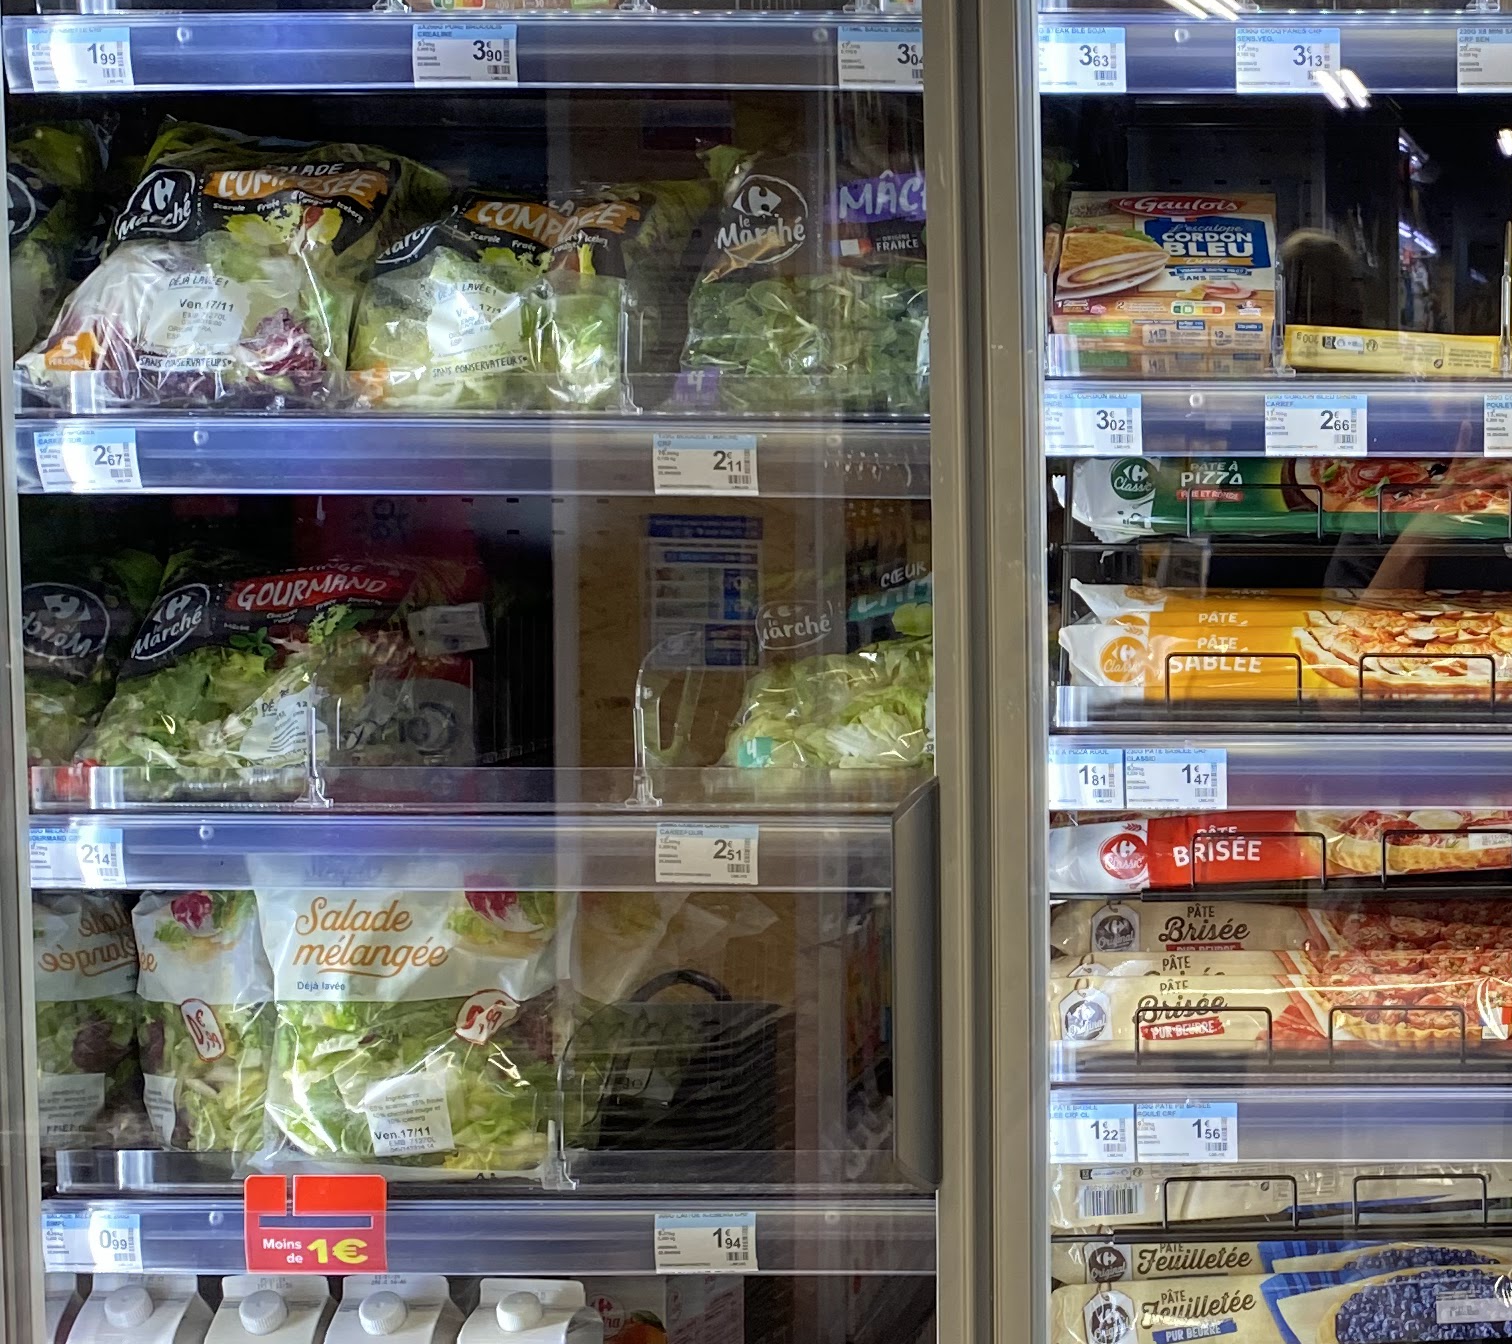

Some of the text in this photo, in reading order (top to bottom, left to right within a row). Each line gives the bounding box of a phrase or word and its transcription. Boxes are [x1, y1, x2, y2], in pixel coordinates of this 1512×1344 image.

[1135, 197, 1238, 212] Gaulois
[739, 216, 750, 228] le
[716, 214, 806, 253] Marché
[1162, 232, 1253, 243] CORDON
[876, 239, 919, 253] FRANCE
[1163, 242, 1254, 257] BLEU
[1181, 472, 1243, 487] PIZZA
[237, 572, 388, 611] GOURMAND
[1198, 611, 1237, 624] PÂTE
[1197, 635, 1238, 650] PÂTE
[1169, 649, 1262, 674] SABLÉE
[1173, 836, 1262, 866] BRISÉE
[296, 896, 414, 936] Salade
[1187, 903, 1215, 918] PÂTE
[1158, 916, 1250, 943] Brisée
[293, 938, 449, 978] mélangée
[1162, 954, 1191, 971] PÂTE
[297, 980, 346, 992] Déjà lavée
[1160, 979, 1189, 994] PÂTE
[1132, 993, 1228, 1025] Brisée
[1152, 1026, 1172, 1040] PUR
[262, 1237, 302, 1251] Moins
[307, 1238, 368, 1264] 1€
[287, 1252, 303, 1264] de
[1137, 1246, 1253, 1274] Feuilletée
[1161, 1288, 1186, 1305] PÂTE
[1140, 1289, 1256, 1330] Feuilletée
[1165, 1325, 1222, 1343] PUR BEURRE
